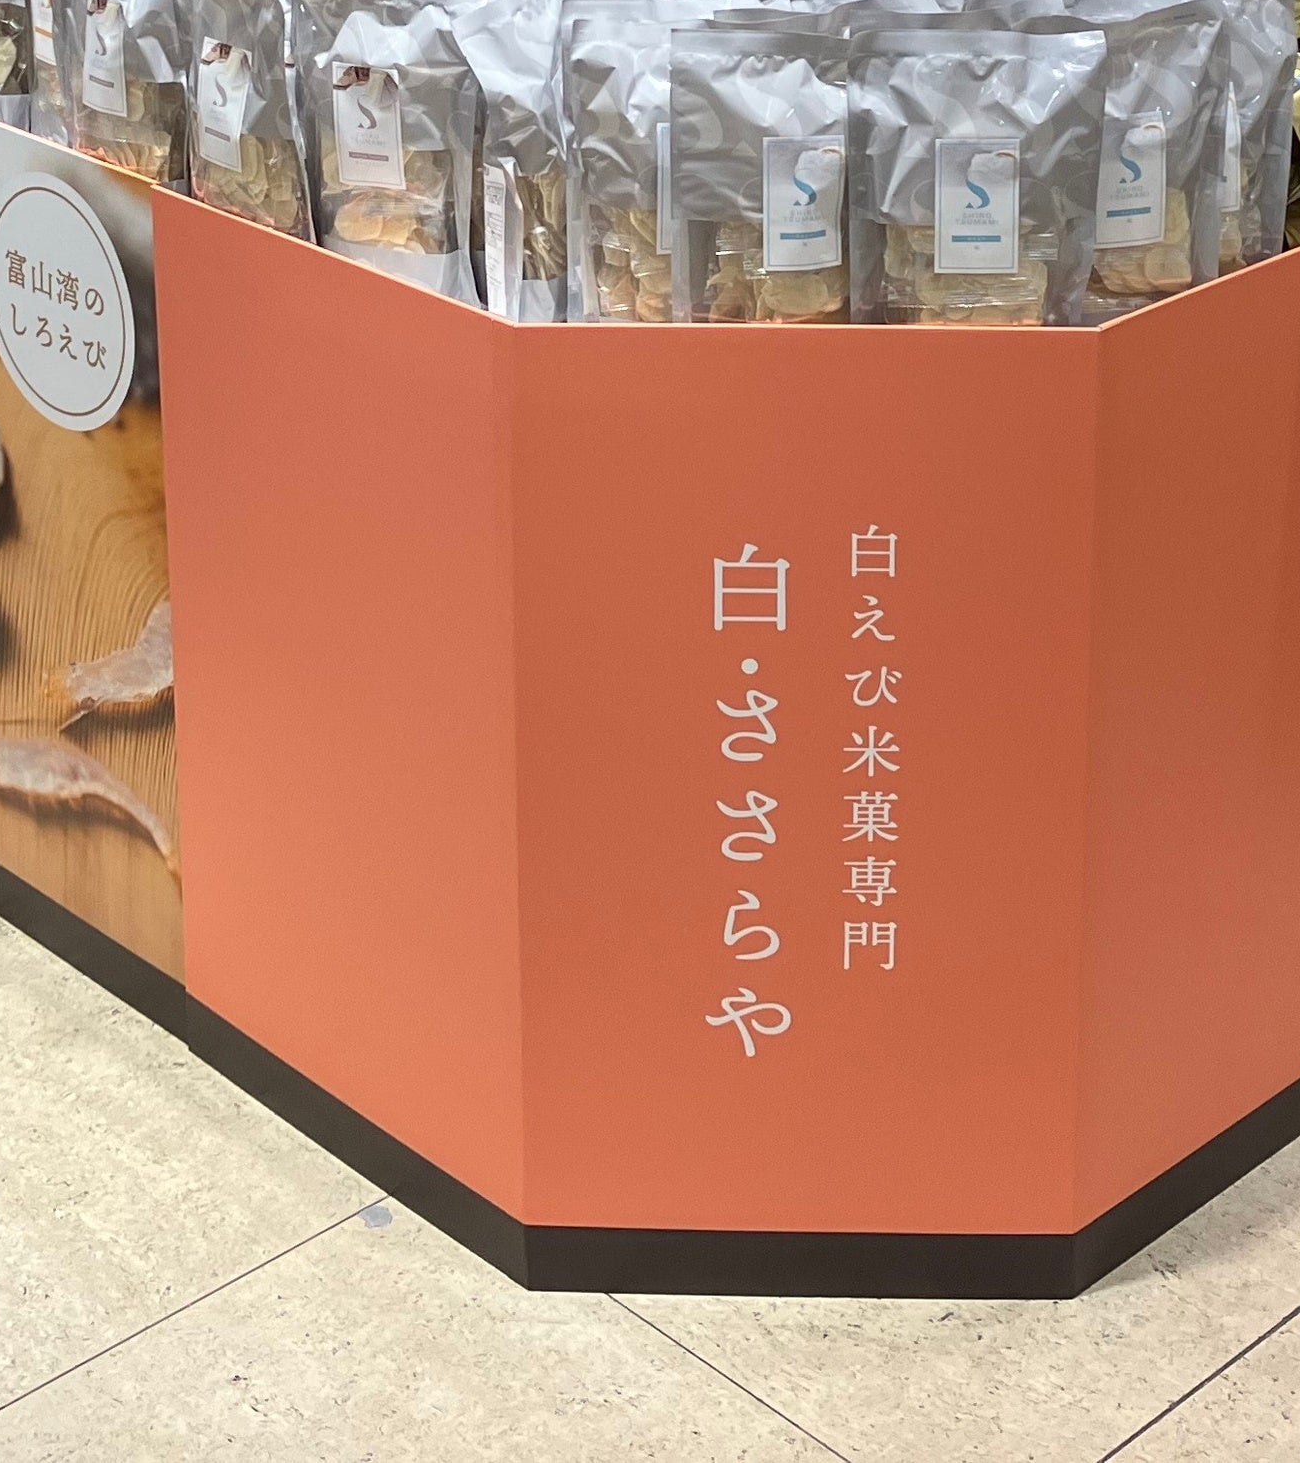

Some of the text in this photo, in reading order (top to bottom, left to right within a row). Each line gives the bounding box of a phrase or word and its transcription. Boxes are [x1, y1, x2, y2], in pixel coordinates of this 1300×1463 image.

[5, 249, 105, 316] 富山湾の
[11, 303, 106, 370] しろえび
[704, 542, 792, 1058] 白・ささらや
[842, 524, 902, 971] 白えび米菓専門
